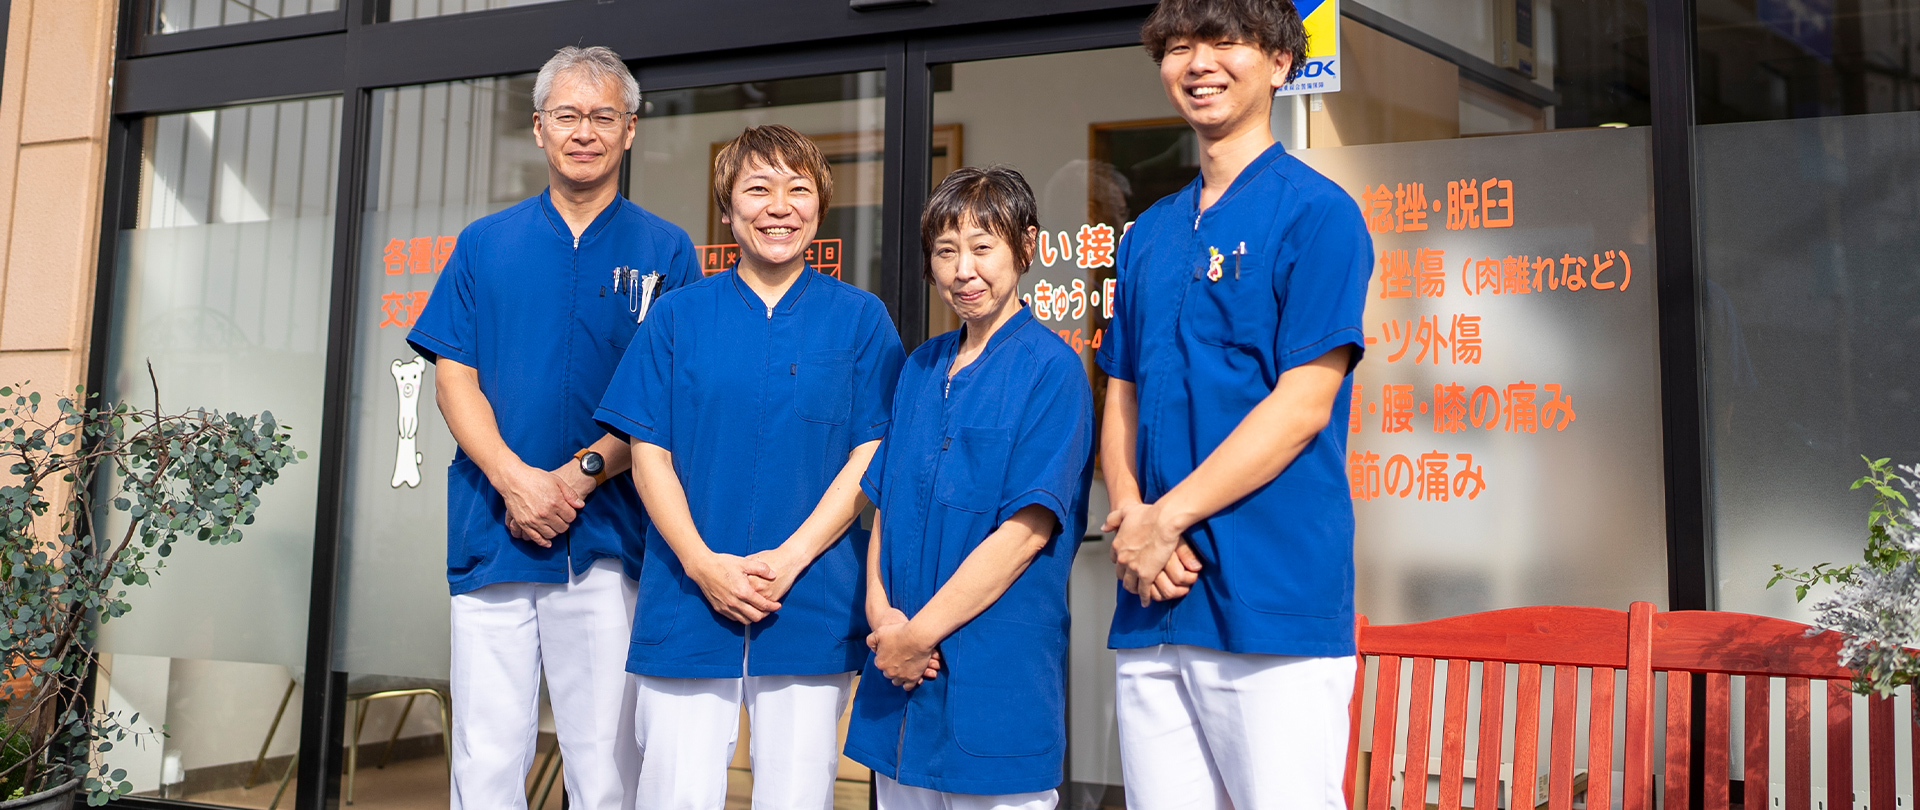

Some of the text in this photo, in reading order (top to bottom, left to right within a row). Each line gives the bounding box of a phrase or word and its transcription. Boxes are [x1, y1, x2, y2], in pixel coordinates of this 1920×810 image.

[1361, 177, 1514, 234] 捻挫・脱臼
[708, 246, 834, 265] 月 火 土 日
[1039, 222, 1135, 268] い接
[380, 290, 431, 329] 交通
[1052, 328, 1107, 354] 76-4
[1348, 449, 1486, 502] 節の痛み
